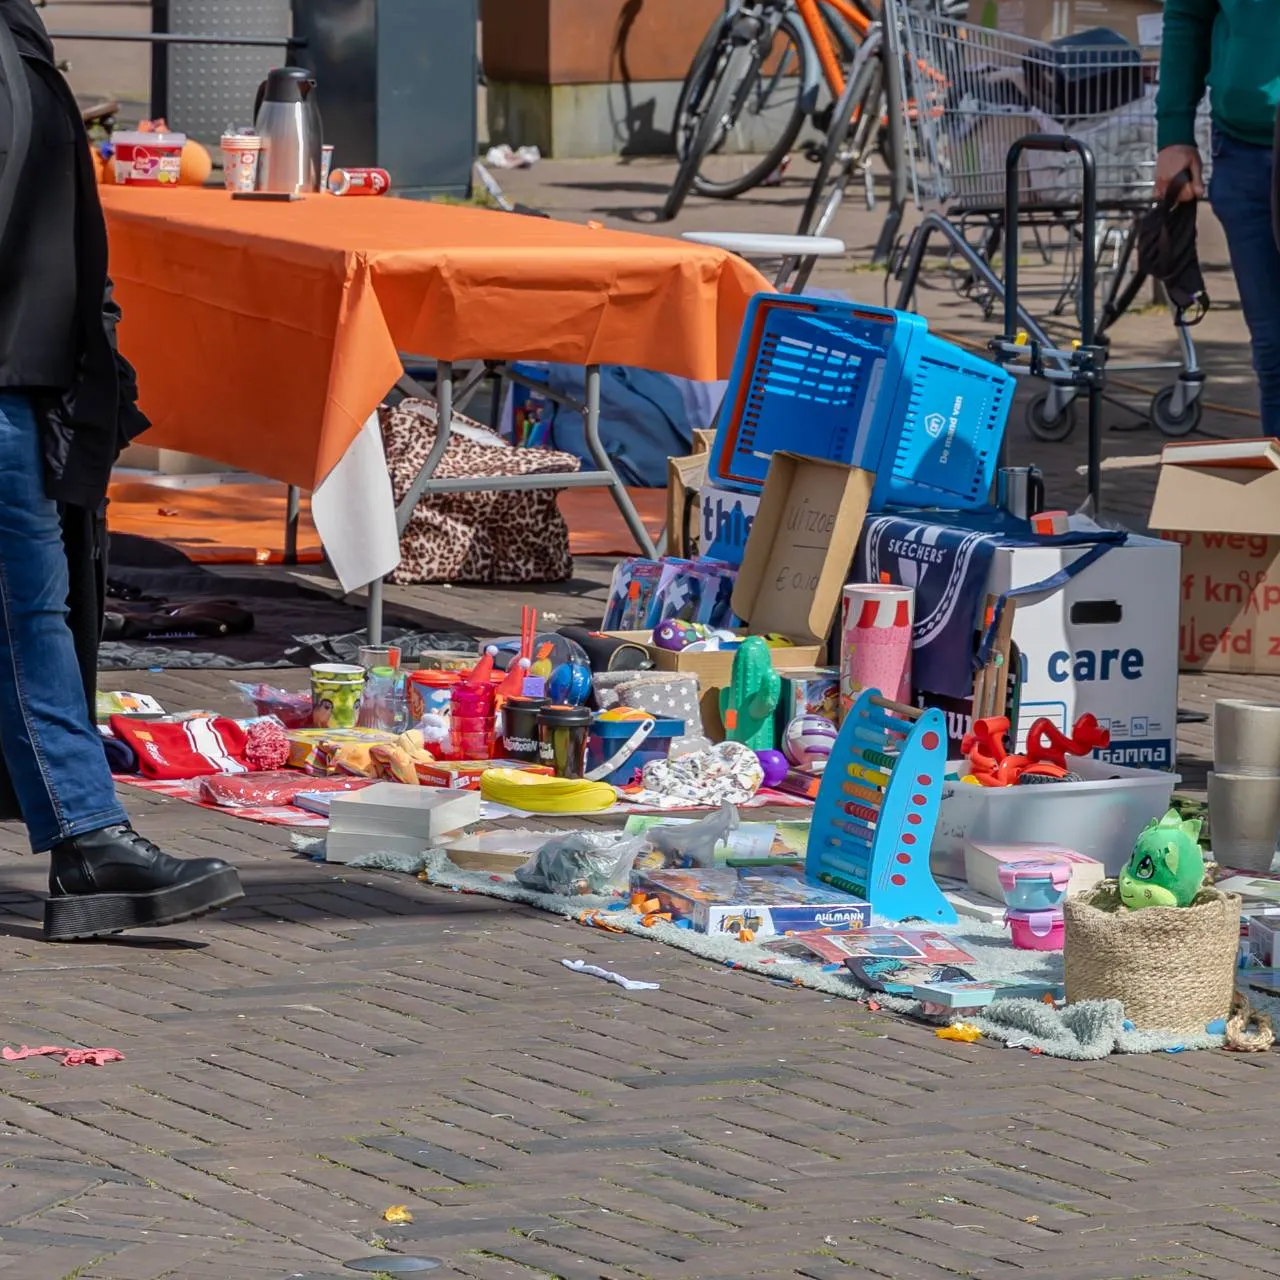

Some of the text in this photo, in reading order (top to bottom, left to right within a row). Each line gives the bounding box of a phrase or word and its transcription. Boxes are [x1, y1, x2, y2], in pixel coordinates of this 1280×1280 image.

[888, 539, 945, 564] SKECHERS
[1047, 648, 1144, 683] care
[814, 912, 865, 921] AHLMANN
